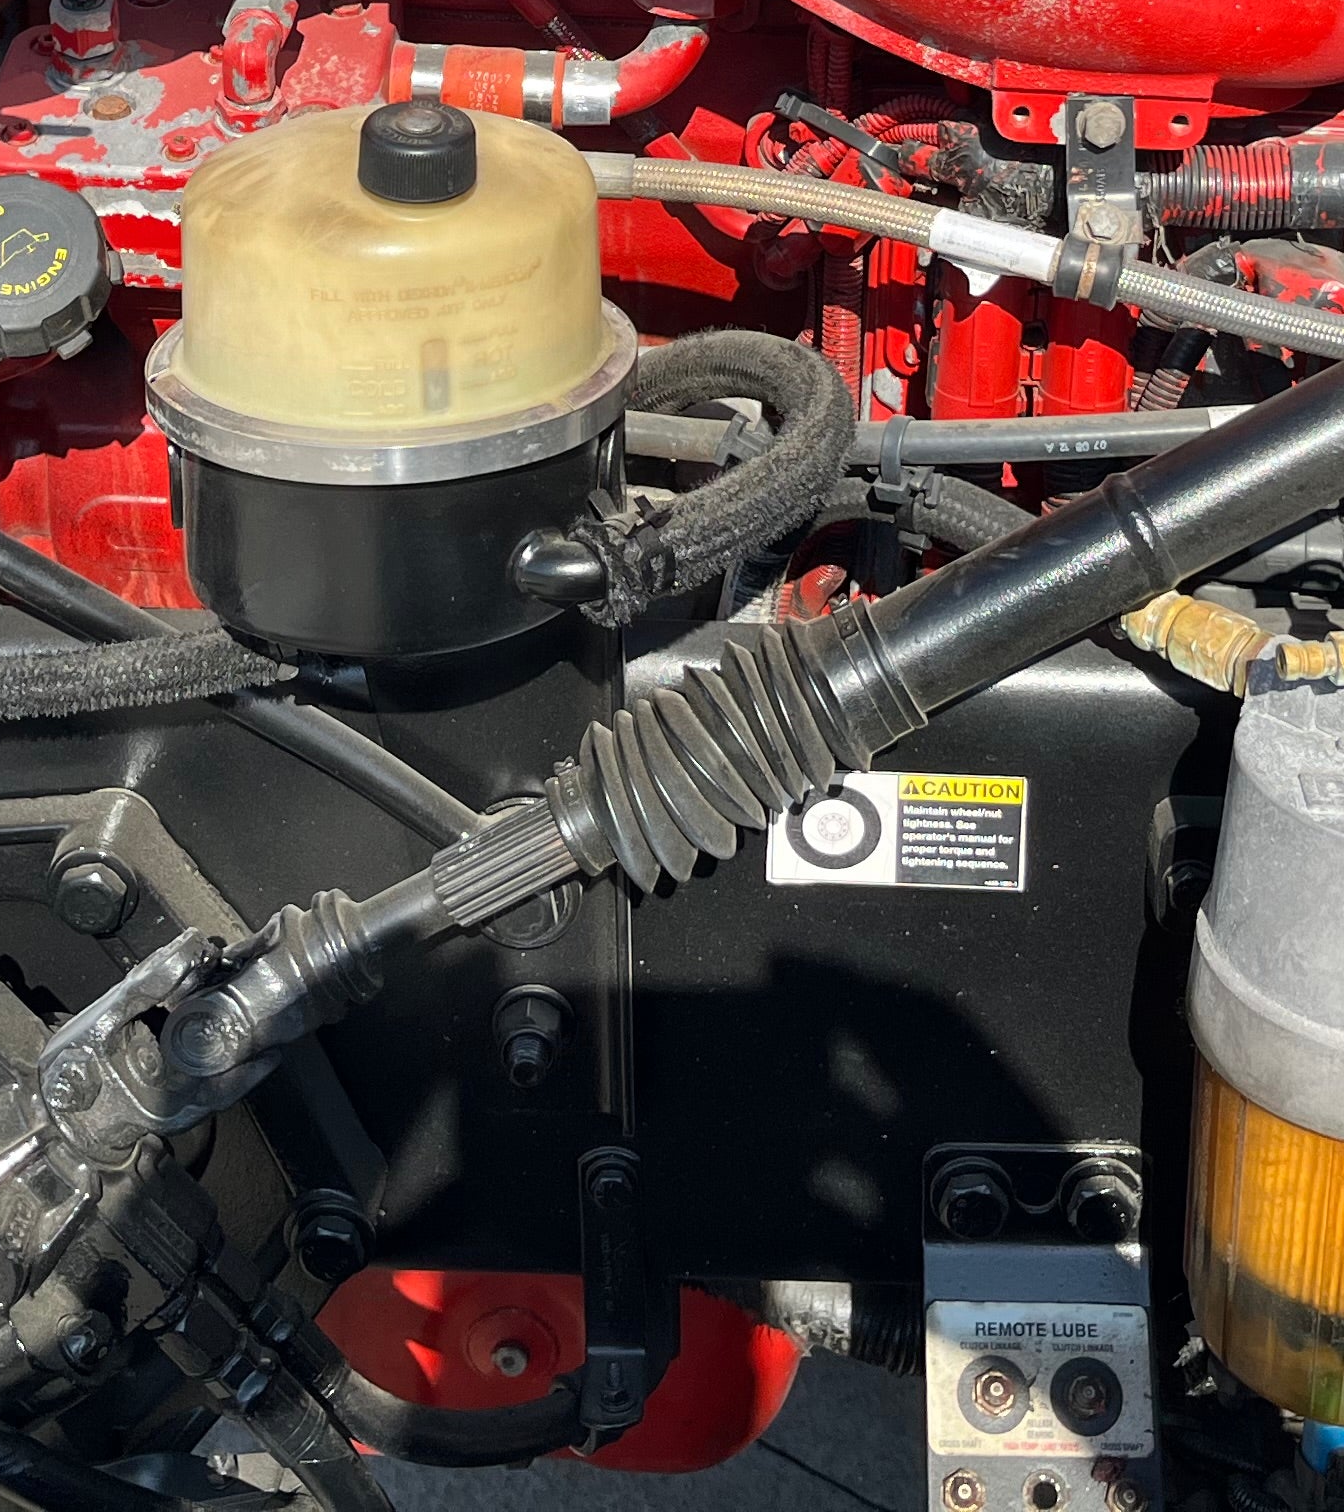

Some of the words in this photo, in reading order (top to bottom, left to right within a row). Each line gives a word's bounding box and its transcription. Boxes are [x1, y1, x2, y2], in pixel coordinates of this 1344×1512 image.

[0, 247, 69, 296] ENGINE
[310, 288, 344, 302] FILL
[921, 781, 1020, 799] CAUTION
[903, 805, 949, 817] Maintain
[950, 808, 1003, 819] wheel/nut
[903, 818, 954, 830] tightness.
[955, 820, 977, 830] See
[902, 831, 956, 843] operator's
[958, 834, 997, 844] manual
[998, 834, 1014, 845] for
[902, 845, 938, 855] proper
[939, 845, 974, 857] torque
[975, 846, 996, 857] and
[902, 856, 954, 869] tightening
[955, 859, 1009, 872] sequence.
[975, 1322, 1047, 1337] REMOTE
[1052, 1323, 1099, 1338] LUBE
